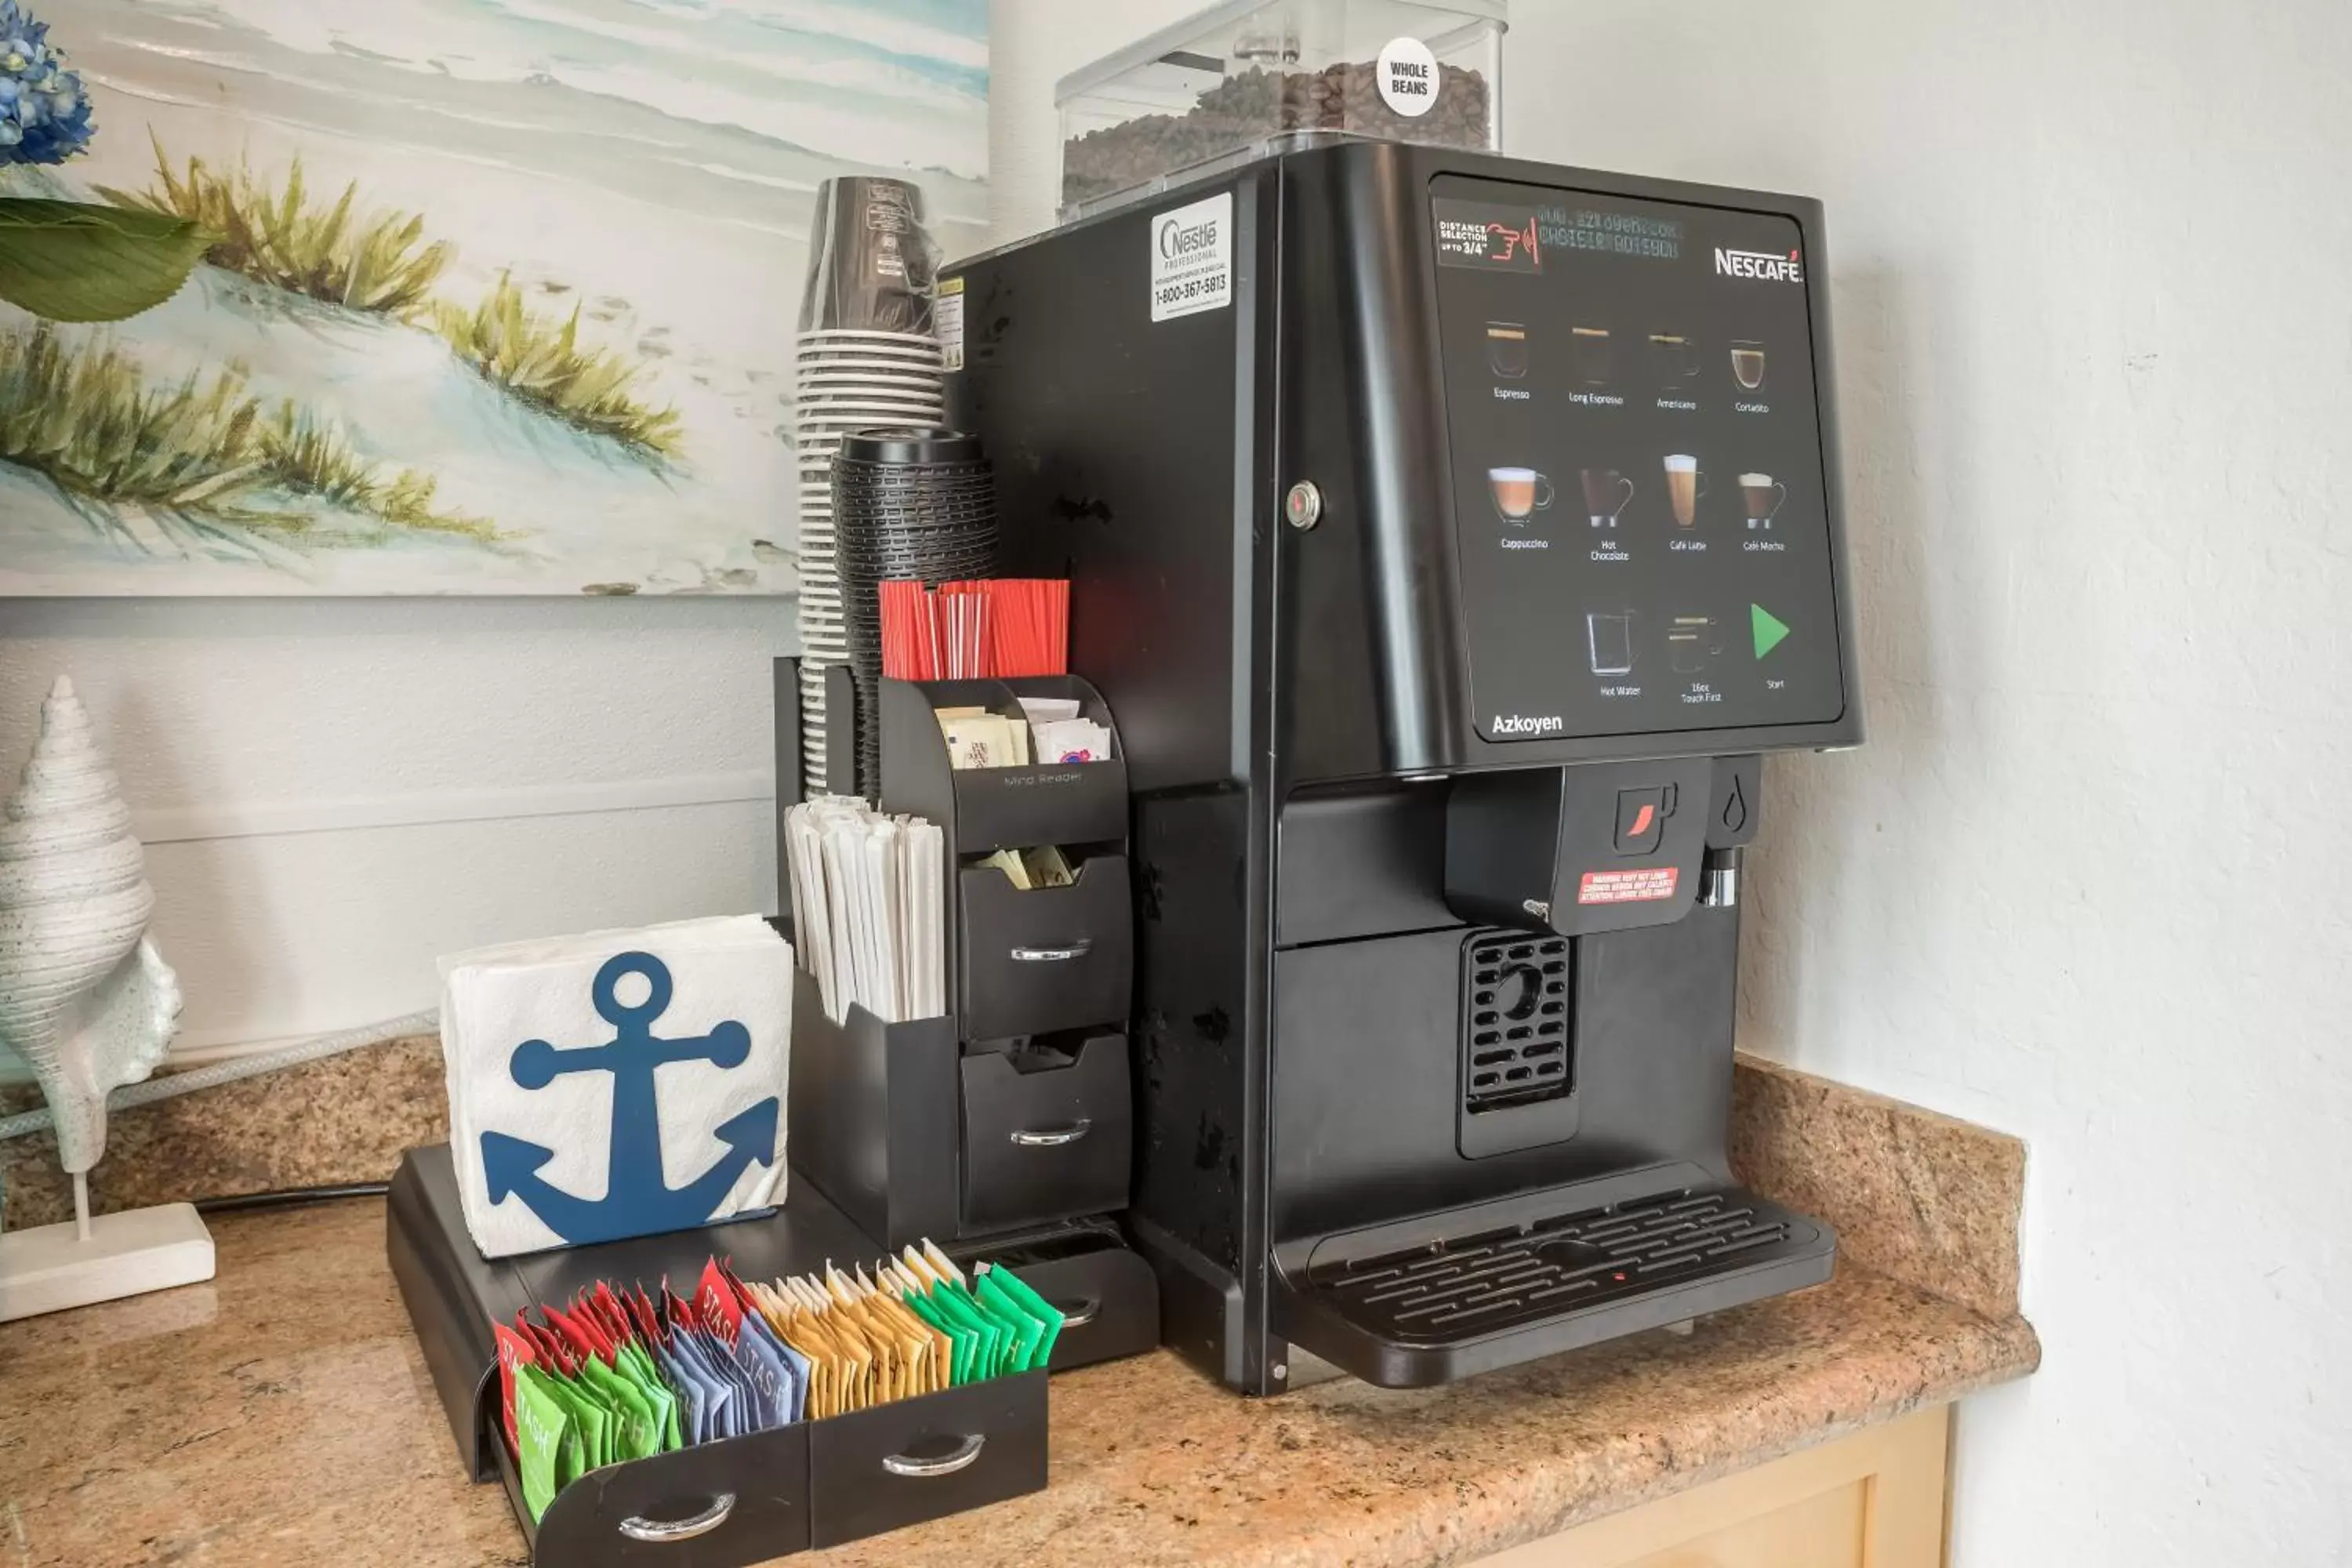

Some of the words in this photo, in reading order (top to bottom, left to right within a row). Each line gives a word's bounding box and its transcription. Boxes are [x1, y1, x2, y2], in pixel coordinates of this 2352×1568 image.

[1390, 62, 1428, 78] WHOLE
[1392, 79, 1428, 95] BEANS
[1439, 220, 1486, 234] DISTANCE
[1440, 230, 1487, 242] SELECTION
[1452, 243, 1461, 252] TO
[1155, 274, 1227, 307] 1-800-367-5813
[1494, 387, 1530, 400] Espresso
[1569, 392, 1588, 405] Long
[1589, 393, 1624, 405] Espresso
[1657, 398, 1697, 410] Americano
[1501, 538, 1548, 550] Cappuccino
[1601, 540, 1617, 550] Hot
[1688, 540, 1707, 550] Latte
[1761, 541, 1785, 551] Mocha
[1591, 550, 1630, 561] Chocolate
[1600, 686, 1615, 696] Hot
[1616, 686, 1641, 696] Water
[1766, 680, 1784, 690] Start
[1492, 714, 1563, 735] Azkoyen
[1038, 772, 1082, 785] Reader
